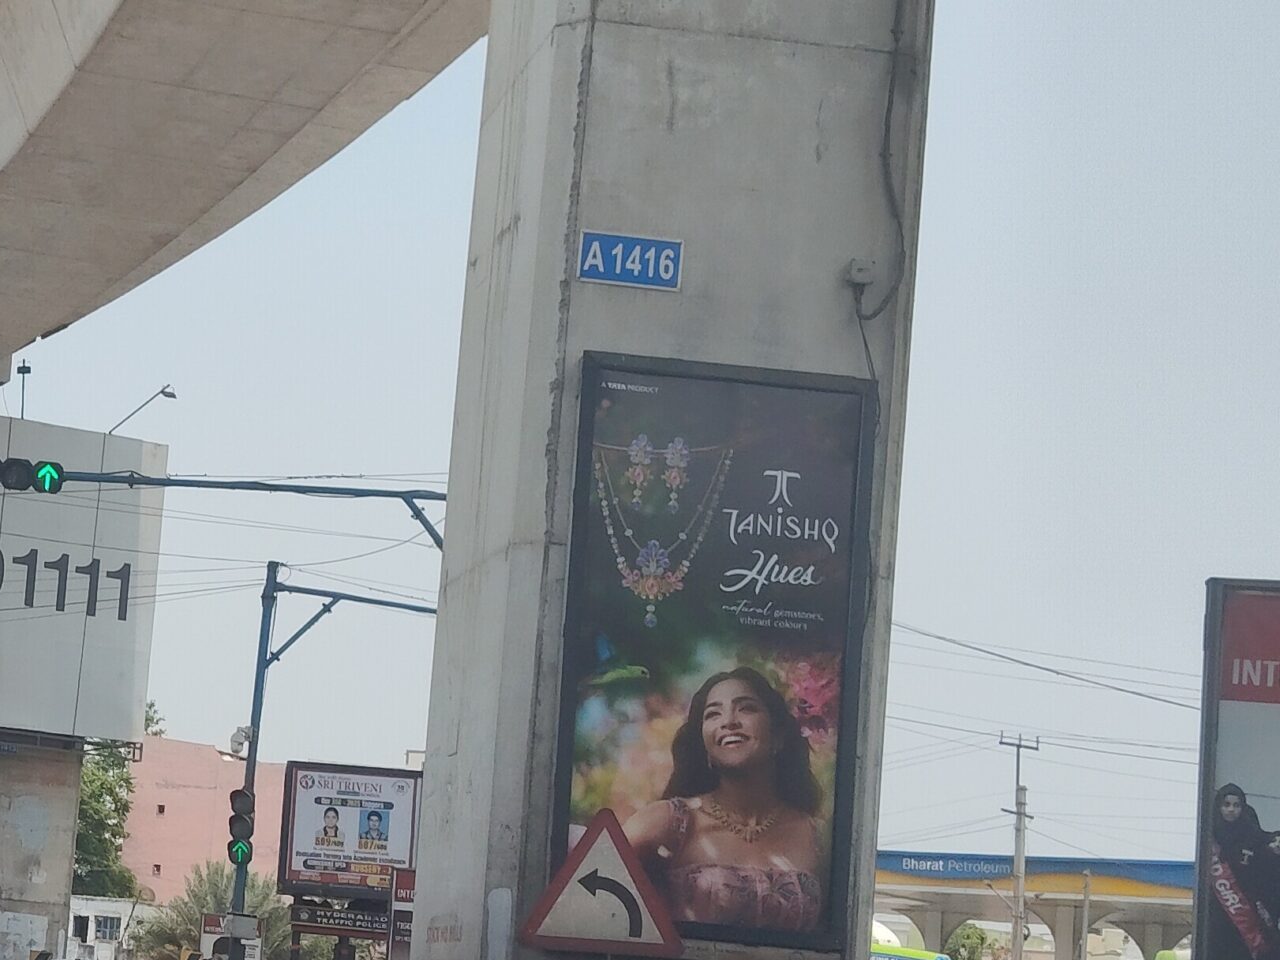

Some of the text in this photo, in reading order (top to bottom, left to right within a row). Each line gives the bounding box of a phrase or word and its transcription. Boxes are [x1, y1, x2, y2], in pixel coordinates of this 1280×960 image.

[583, 240, 675, 280] A 1416
[722, 506, 839, 553] TANISHQ
[720, 550, 821, 595] Hues
[317, 779, 334, 790] SRI
[337, 780, 382, 794] TRIVENI
[902, 857, 1011, 874] Bharat Petroleum
[1216, 879, 1243, 914] GIRL
[316, 917, 353, 927] TRAFFIC
[355, 920, 388, 929] POLICE
